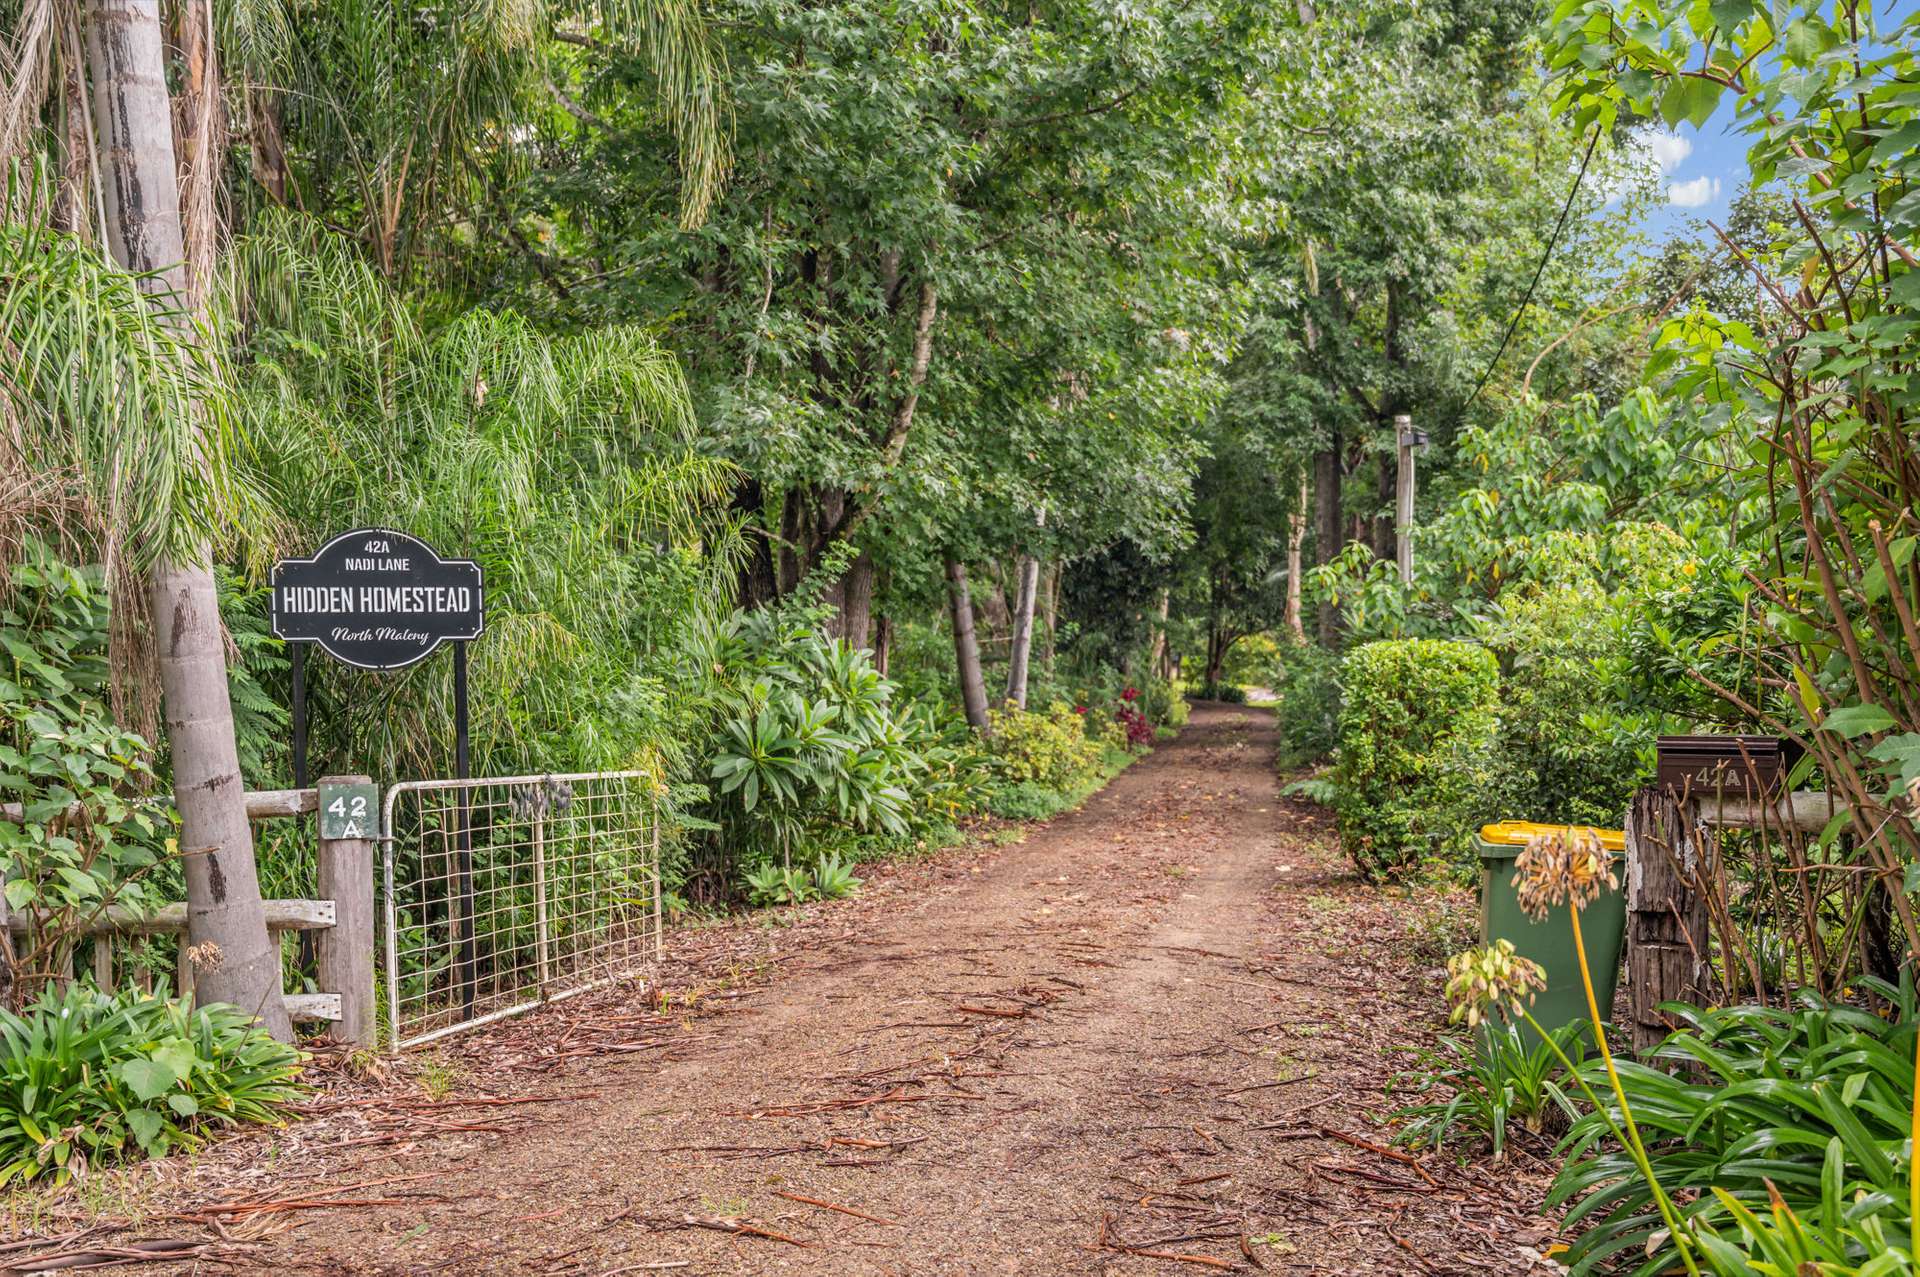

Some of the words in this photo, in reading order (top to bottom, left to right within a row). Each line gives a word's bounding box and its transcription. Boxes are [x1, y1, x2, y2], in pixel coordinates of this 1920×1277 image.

[364, 540, 390, 553] 42A
[345, 558, 375, 571] NADI
[378, 558, 410, 571] LANE
[283, 586, 354, 613] HIDDEN
[360, 586, 470, 613] HOMESTEAD
[331, 626, 373, 642] North
[375, 626, 429, 646] Maleny
[328, 796, 366, 817] 42
[342, 819, 362, 839] A
